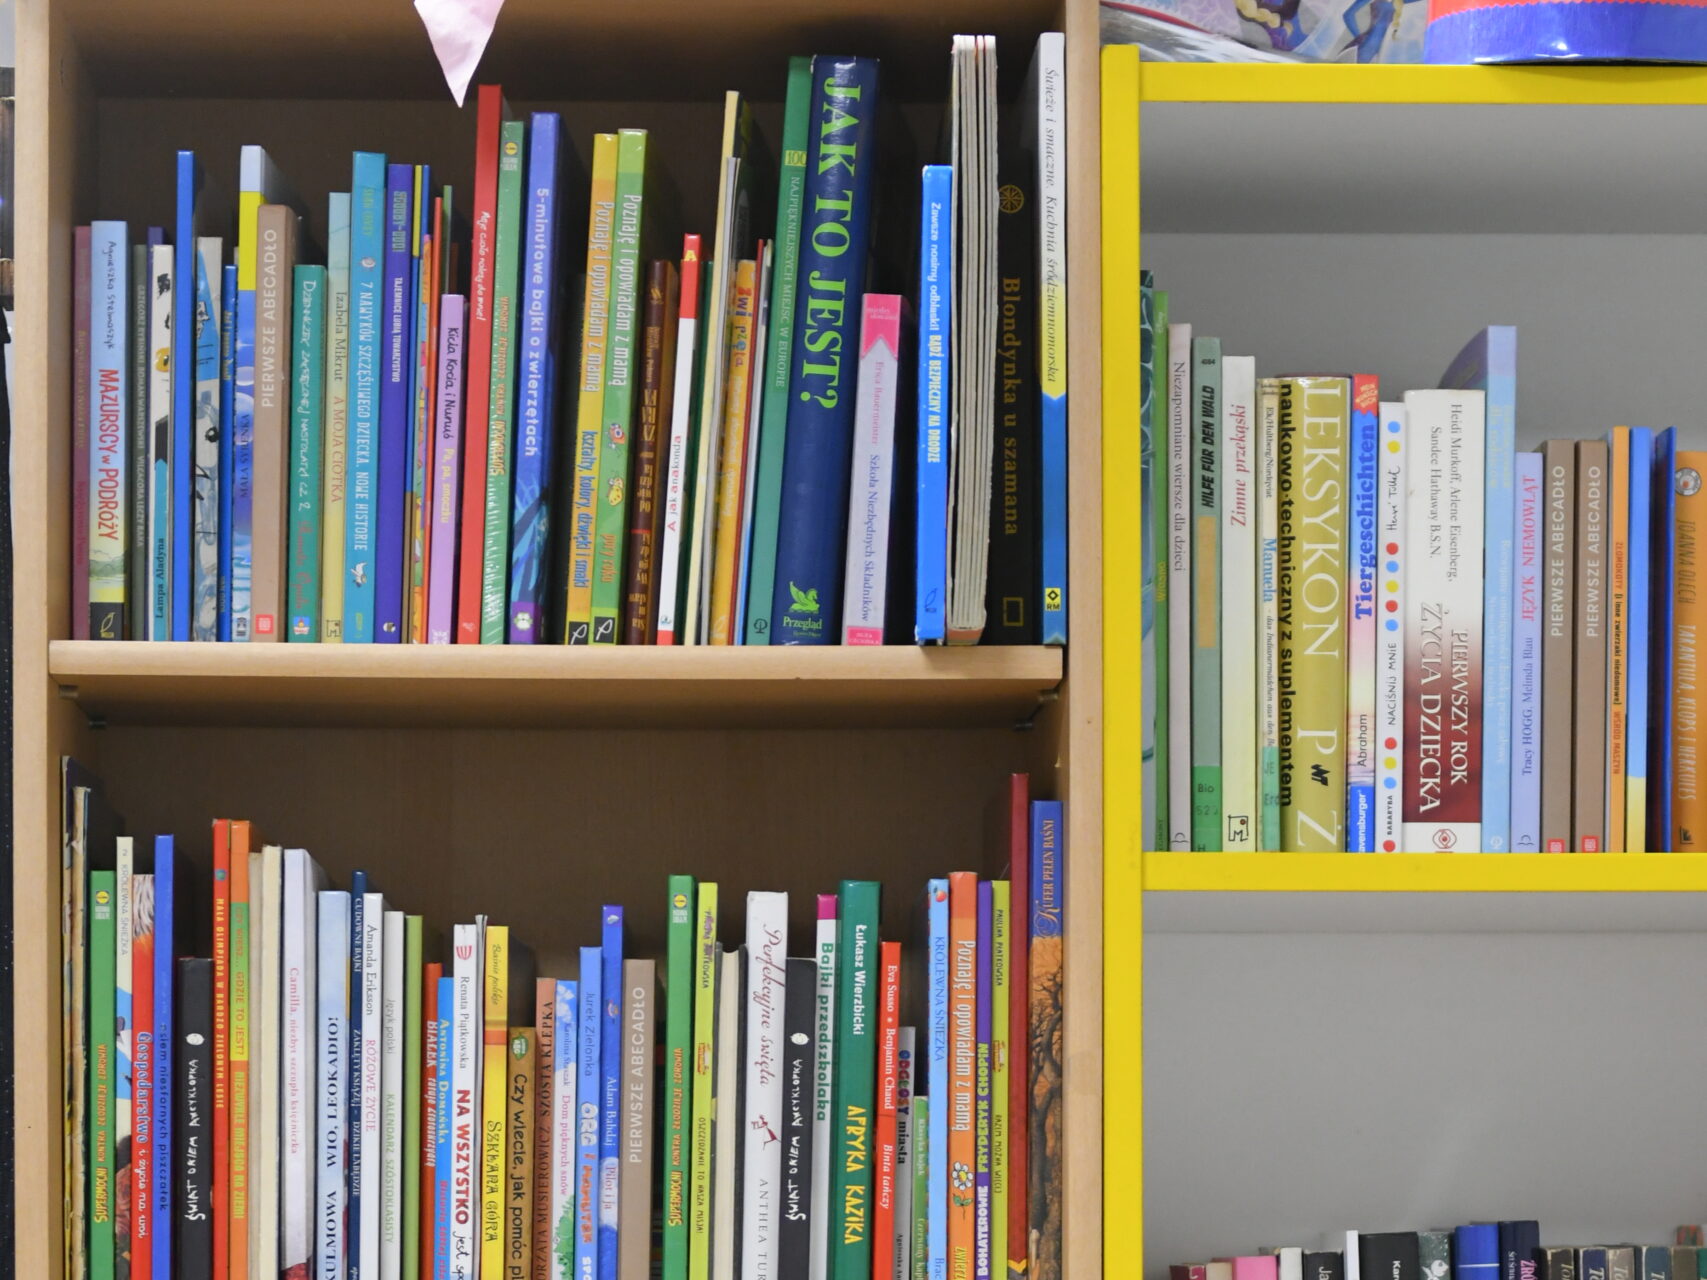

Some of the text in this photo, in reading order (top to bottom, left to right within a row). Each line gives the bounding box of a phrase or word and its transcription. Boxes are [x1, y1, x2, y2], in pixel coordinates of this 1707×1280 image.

[618, 194, 642, 244] Poznaję
[801, 77, 862, 409] JAK TO JEST?
[262, 229, 277, 407] PIERWSZE ABECADŁO
[524, 188, 549, 456] 5-minutowe bajki o zwierzętach
[613, 258, 637, 330] opowiadam
[98, 241, 121, 540] Agnieszka Stelmaszyk MAZURSCY w PODRÓŻY
[609, 347, 629, 387] mamą
[998, 277, 1021, 534] Blondynka u szamana
[1171, 362, 1186, 571] Niezapomniane wiersze dla dzieci
[1201, 385, 1215, 508] HILFE FÜR DEN WALD
[1446, 404, 1462, 582] Heidi Murkoff, Arlene Eisenberg,
[1281, 631, 1291, 643] z
[1296, 384, 1342, 847] LEKSYKON P Ż
[1278, 648, 1294, 807] suplementem
[1418, 602, 1449, 813] ŻYCIA DZIECKA
[1450, 629, 1468, 785] PIERWSZY ROK
[456, 1013, 470, 1068] Piątkowska
[459, 976, 471, 1010] Renata
[815, 943, 834, 1121] Bajki przedszkolaka
[327, 1016, 339, 1118] LEOKADIO!
[456, 1089, 470, 1117] NA
[509, 1074, 527, 1105] Czy
[844, 924, 868, 1244] Łukasz Wierzbicki AFRYKA KAZIKA
[880, 965, 897, 1209] Eva Susso Benjamin Chaud Binta tańczy
[326, 1124, 339, 1166] WIO,
[456, 1124, 471, 1225] WSZYSTKO
[509, 1174, 526, 1201] jak
[451, 1231, 471, 1260] jest
[508, 1206, 526, 1260] pomóc
[757, 1179, 768, 1244] ANTHEA
